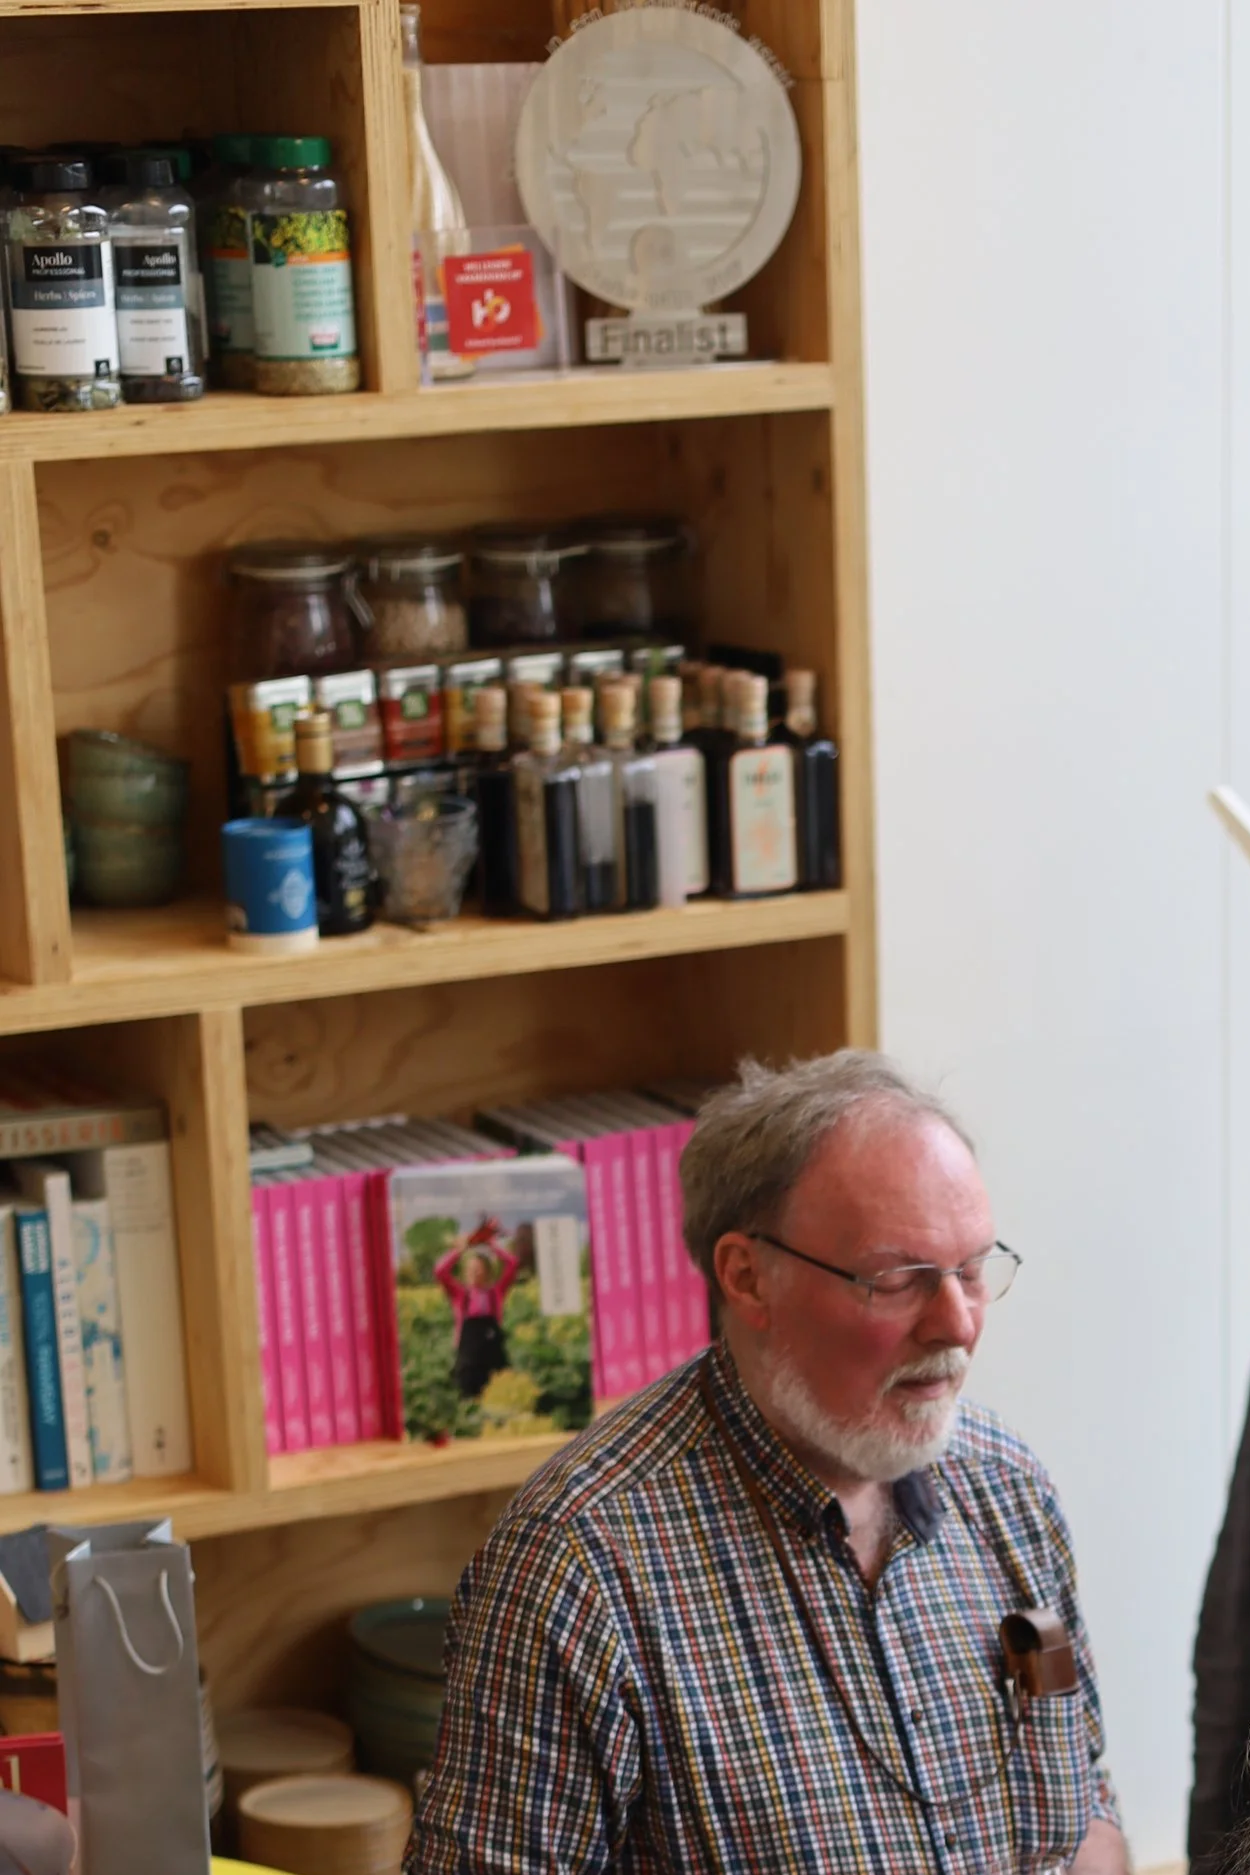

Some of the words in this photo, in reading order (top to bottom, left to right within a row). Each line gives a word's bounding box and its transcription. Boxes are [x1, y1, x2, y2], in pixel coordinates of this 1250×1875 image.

[32, 252, 73, 269] Apollo
[142, 252, 177, 268] Apollo
[600, 321, 728, 355] Finalist
